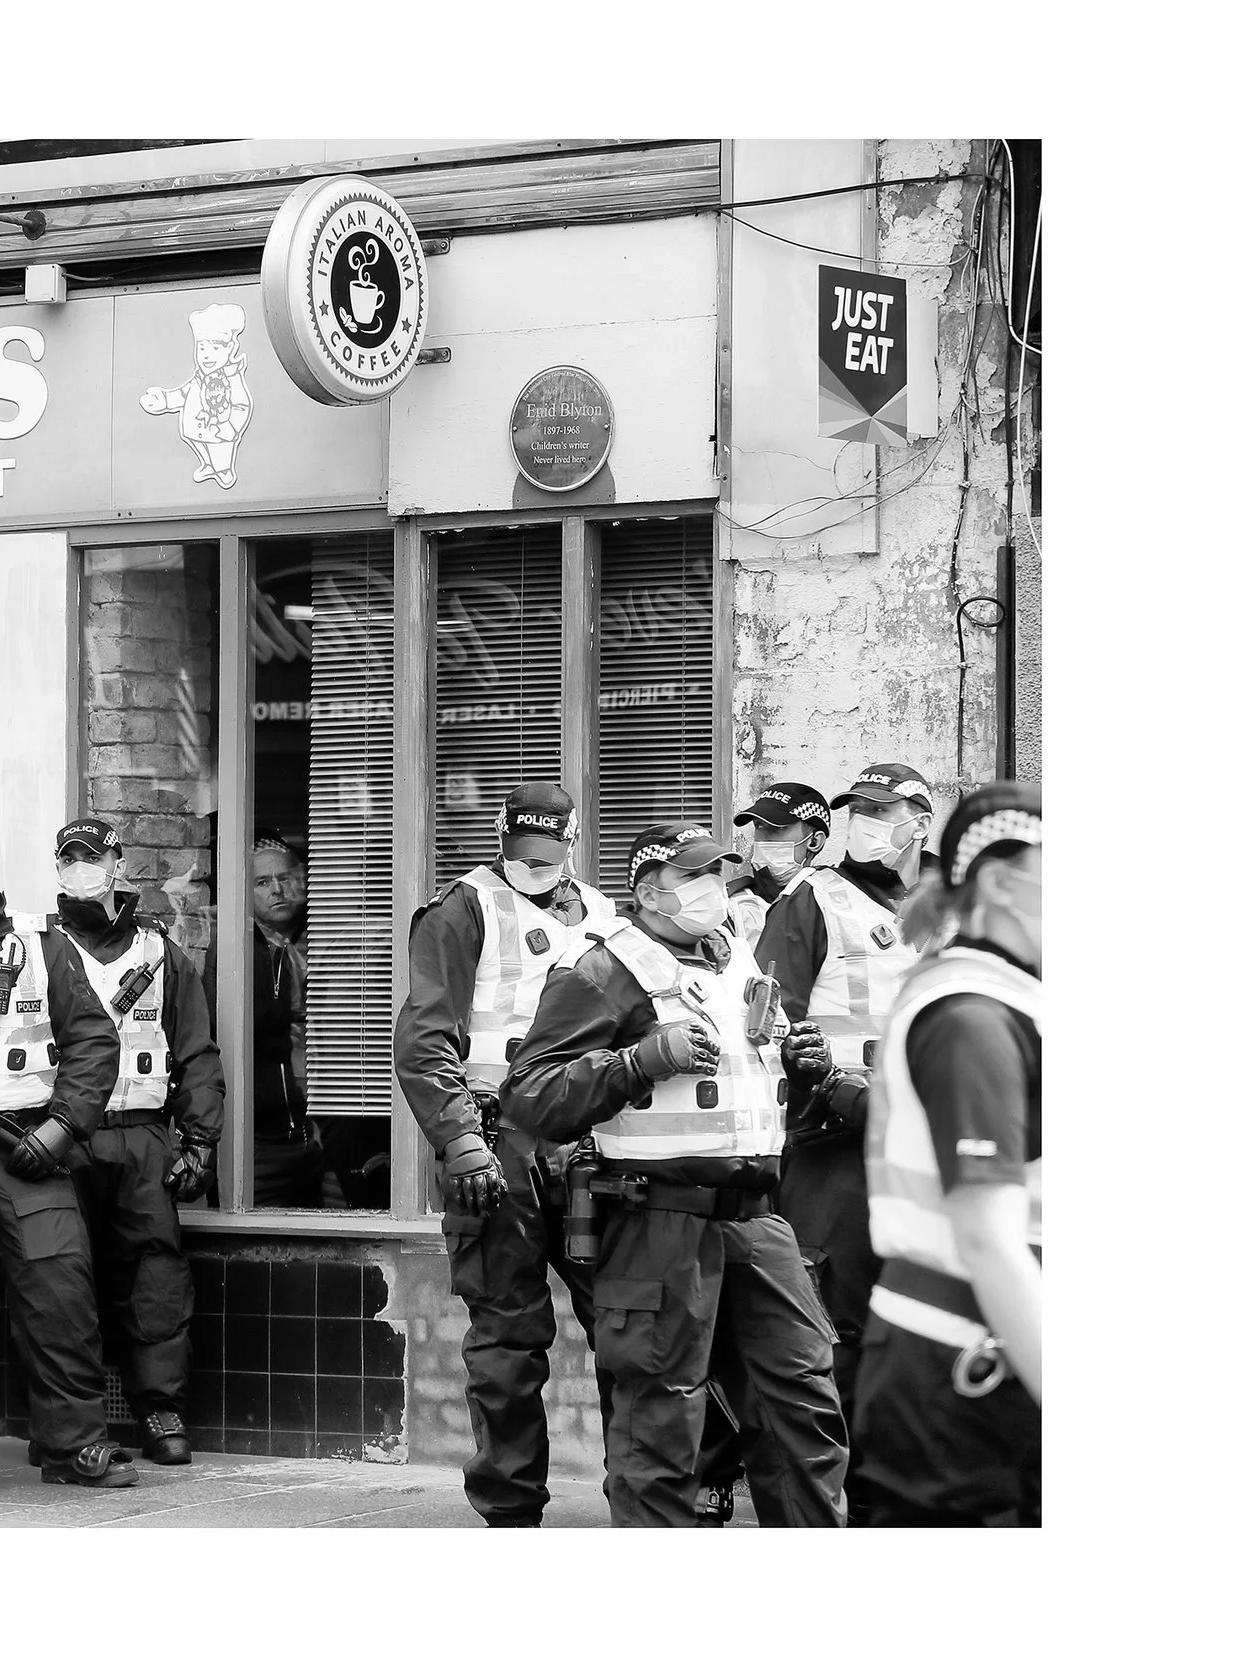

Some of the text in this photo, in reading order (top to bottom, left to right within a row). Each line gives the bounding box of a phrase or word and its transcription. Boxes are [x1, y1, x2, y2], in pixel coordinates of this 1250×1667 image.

[318, 210, 415, 291] ITALIAN AROMA
[831, 286, 894, 332] JUST
[330, 331, 401, 371] COFFEE
[845, 332, 894, 375] EAT
[526, 402, 602, 420] Enid Blyton
[543, 426, 581, 435] 1897-1968
[531, 441, 590, 451] Children's writer
[533, 456, 554, 464] Never
[554, 455, 571, 464] lived
[857, 773, 892, 786] OLICE
[759, 790, 792, 804] OLICE
[516, 814, 559, 829] POLICE
[63, 825, 99, 838] POLICE
[17, 1001, 41, 1012] POLICE
[134, 1010, 156, 1020] POLICE
